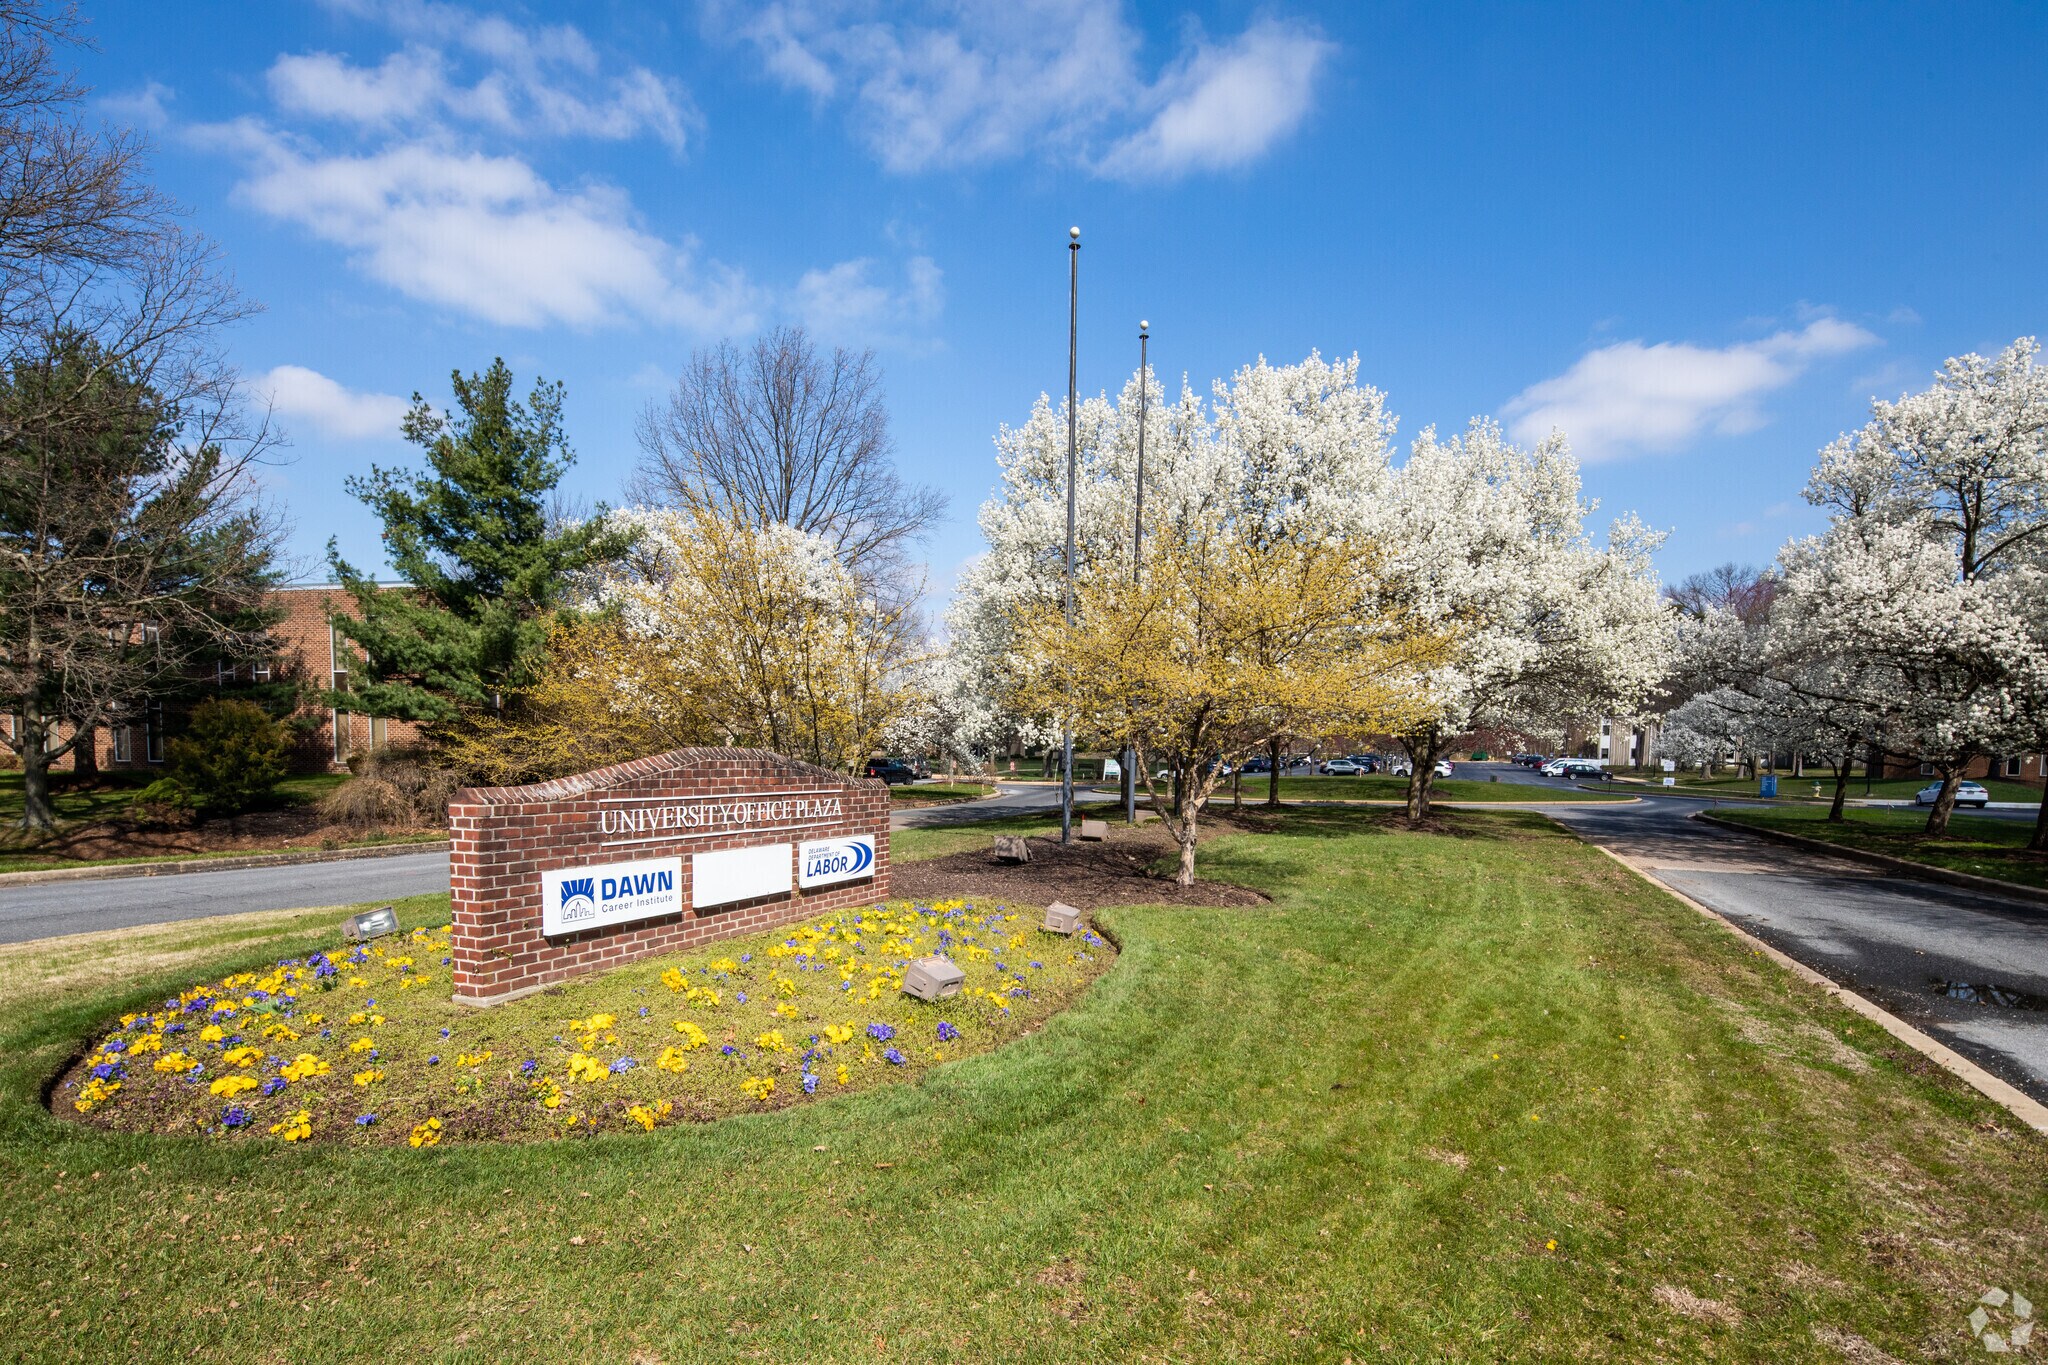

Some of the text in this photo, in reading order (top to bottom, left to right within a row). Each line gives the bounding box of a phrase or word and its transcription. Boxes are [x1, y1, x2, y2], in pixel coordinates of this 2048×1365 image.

[601, 798, 842, 834] UNIVERSITY OFFICE PLAZA
[808, 846, 830, 854] DELAWARE
[808, 852, 835, 860] DEPARTMENT
[806, 856, 848, 877] LABOR
[601, 870, 673, 901] DAWN
[601, 894, 673, 913] Career Institute
